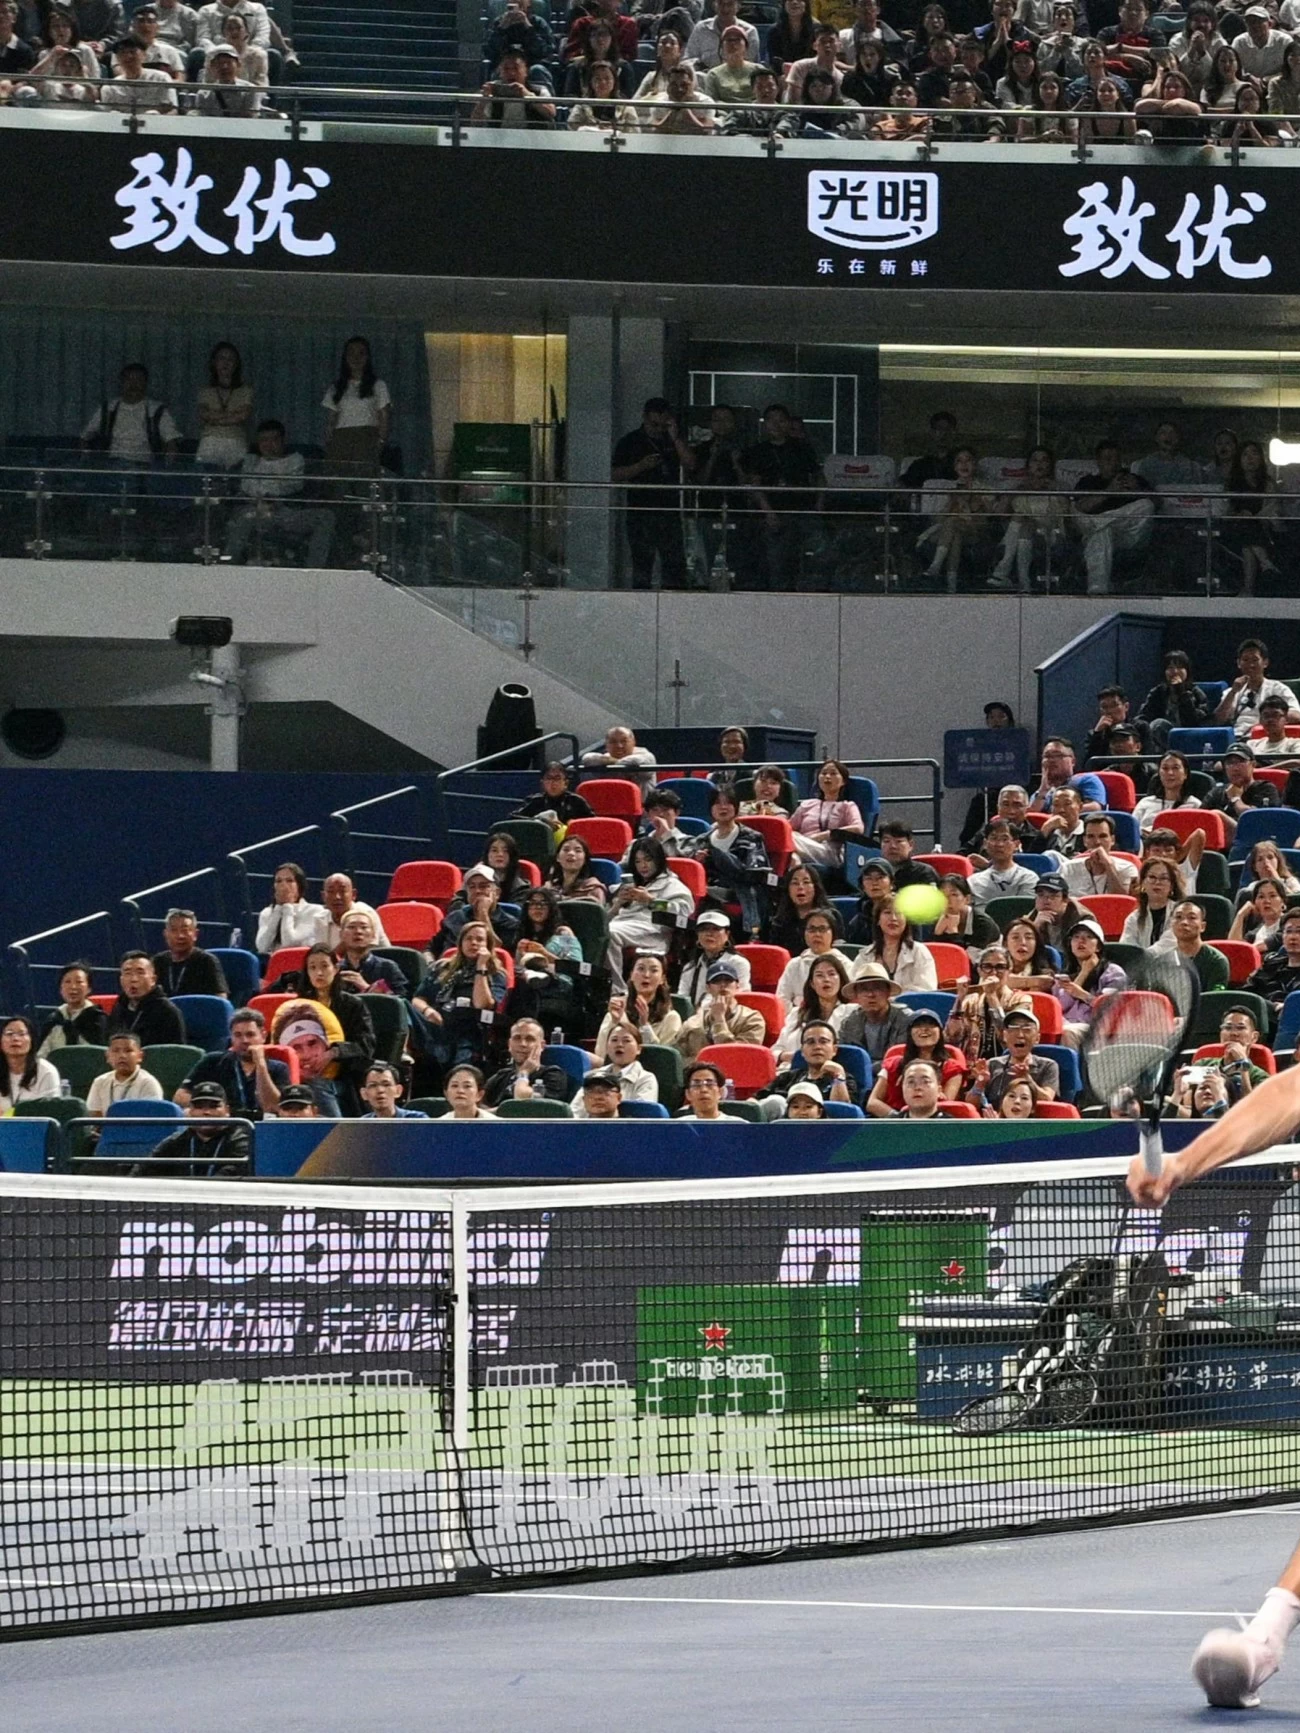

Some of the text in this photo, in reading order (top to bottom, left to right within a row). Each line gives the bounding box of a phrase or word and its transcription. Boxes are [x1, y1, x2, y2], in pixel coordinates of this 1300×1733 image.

[109, 147, 336, 257] 致优
[818, 177, 927, 221] 光明
[1058, 175, 1272, 280] 致优
[816, 258, 928, 276] 乐在新鲜
